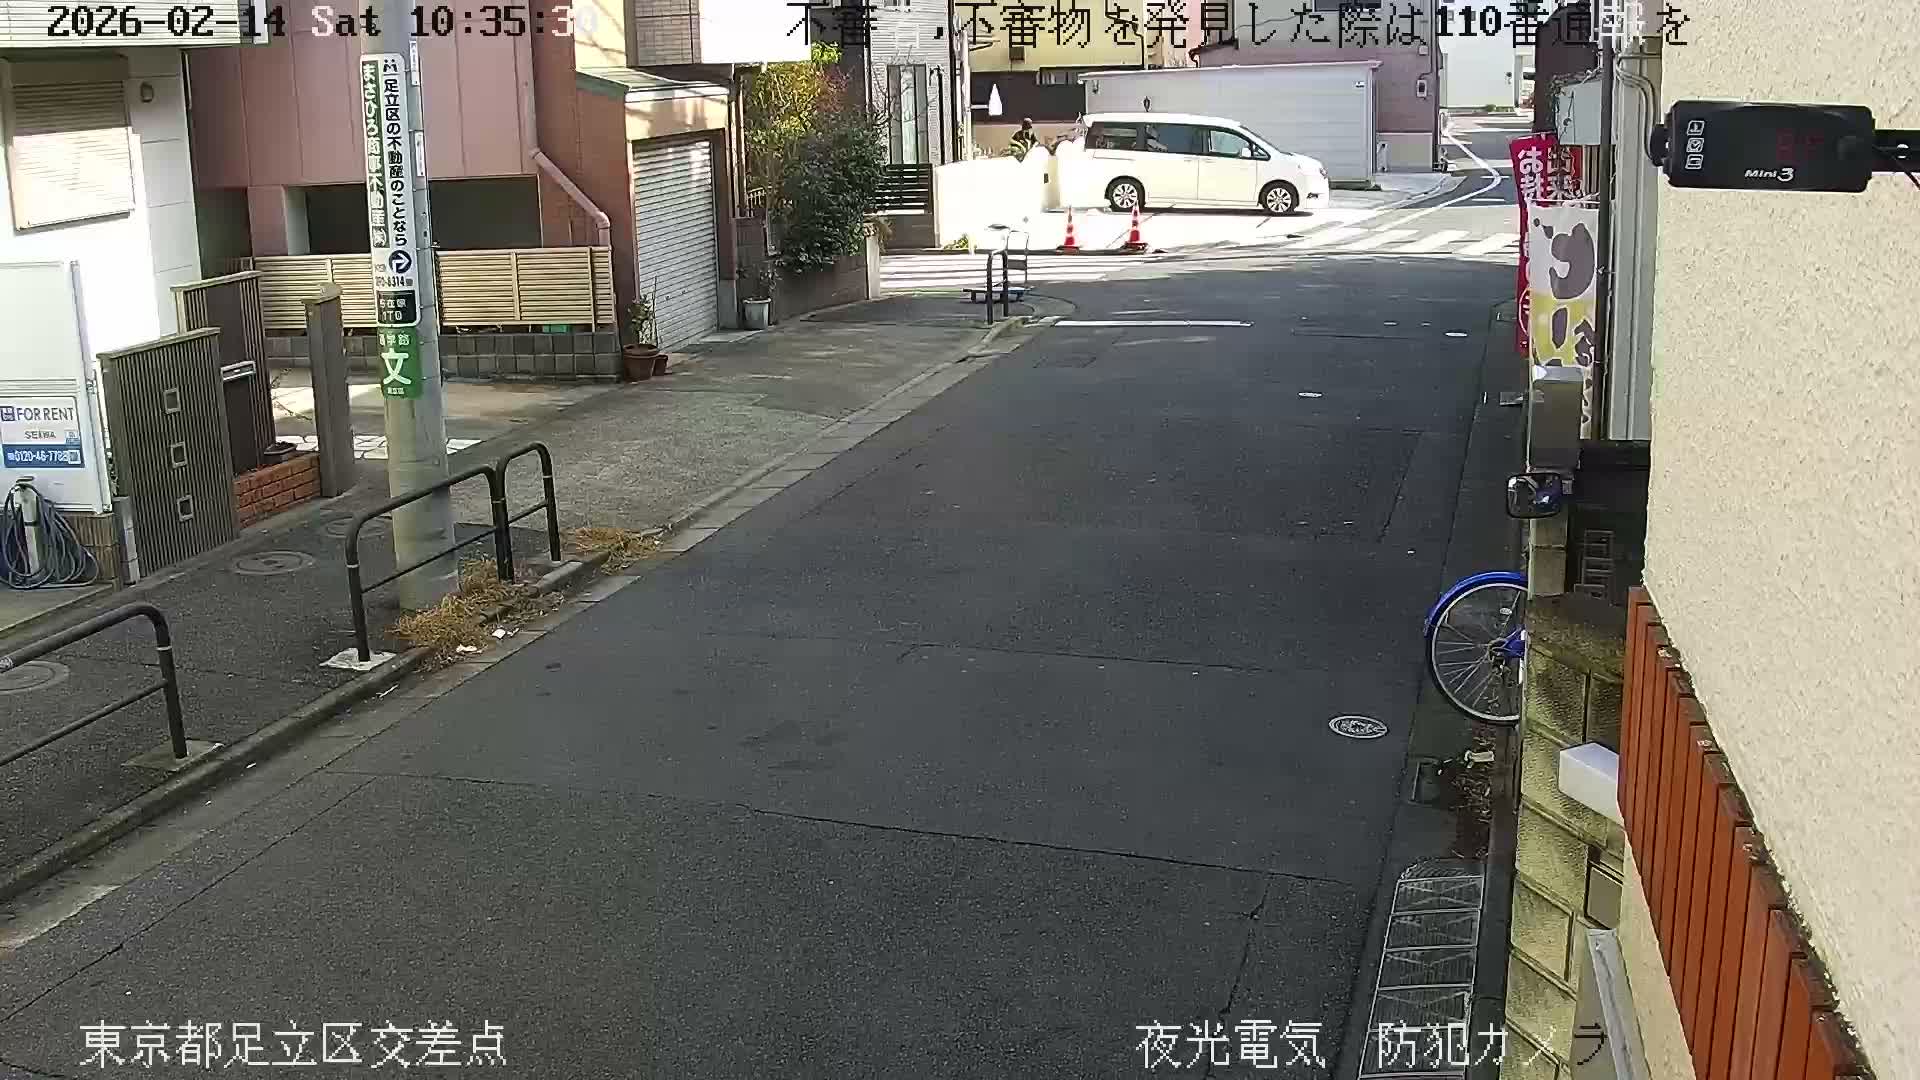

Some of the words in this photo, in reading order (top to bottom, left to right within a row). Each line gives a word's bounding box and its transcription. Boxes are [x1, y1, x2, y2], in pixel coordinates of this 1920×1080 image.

[384, 79, 407, 246] 足立区の不動産のことなら
[381, 348, 411, 384] 文
[16, 407, 41, 421] FOR
[43, 407, 74, 421] RENT
